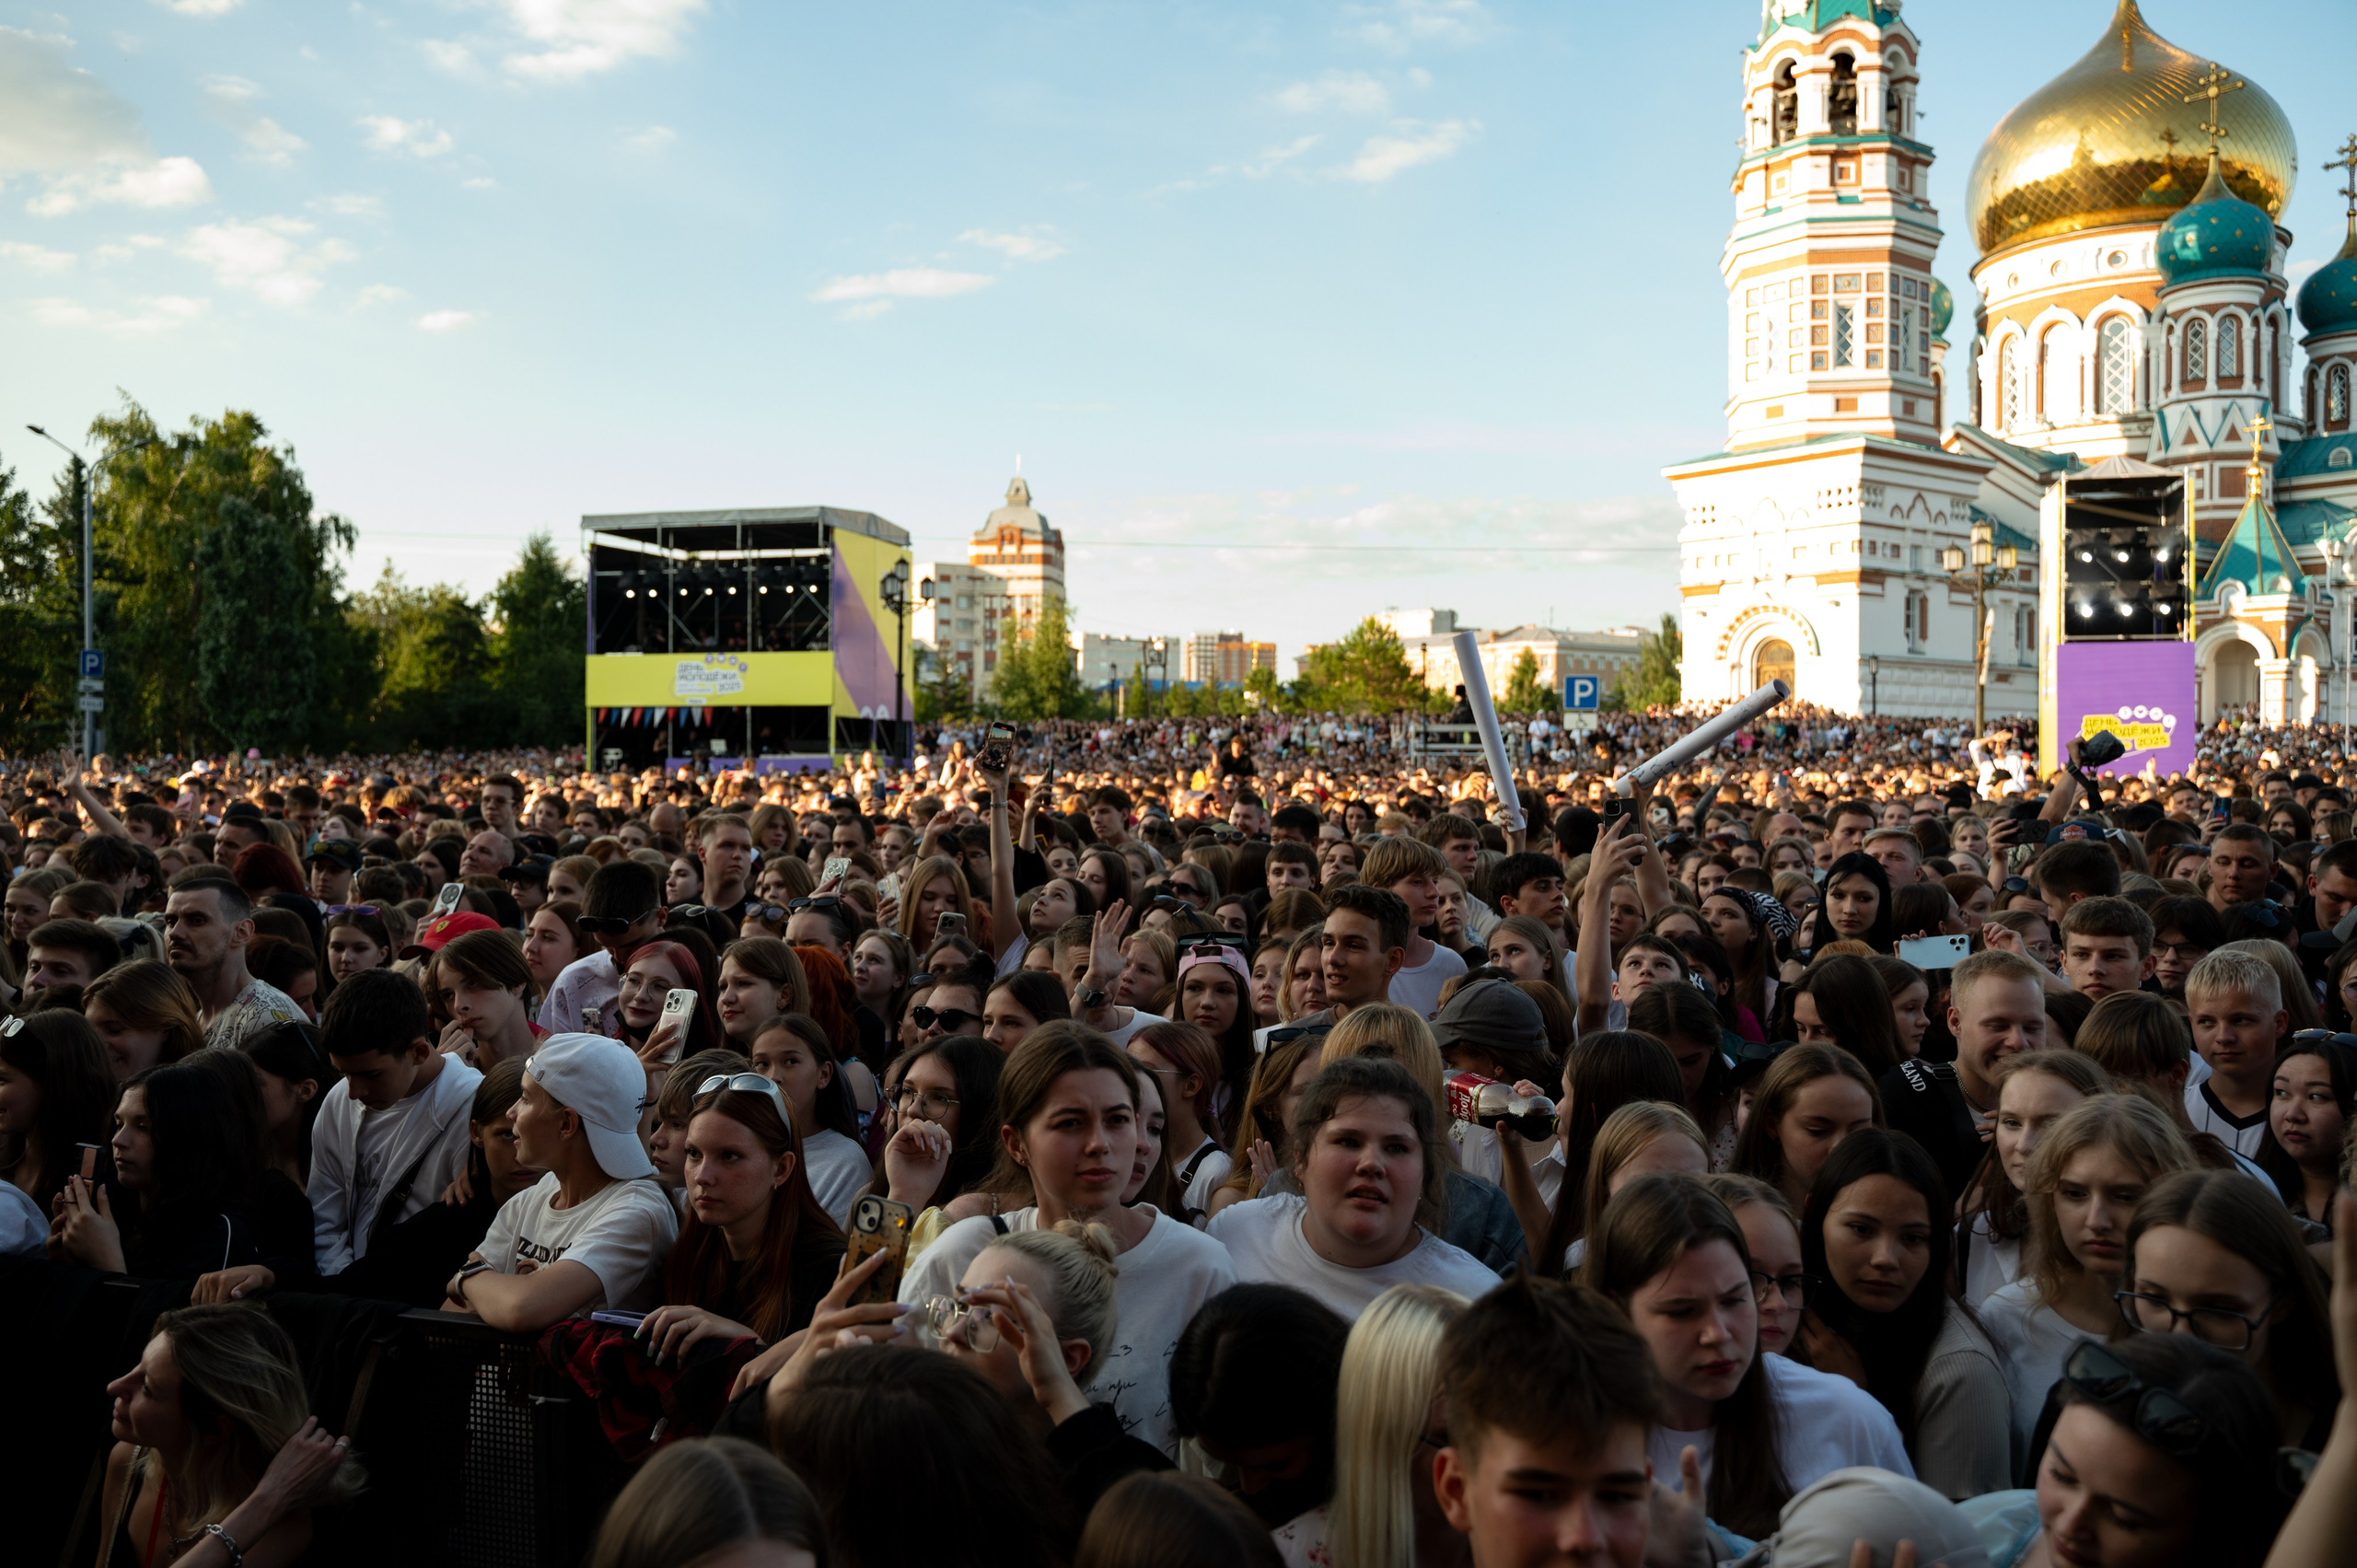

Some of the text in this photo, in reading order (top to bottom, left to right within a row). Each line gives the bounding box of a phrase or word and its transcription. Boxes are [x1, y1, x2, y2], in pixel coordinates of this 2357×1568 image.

[86, 653, 99, 674] P
[1573, 679, 1595, 706] P
[2084, 717, 2118, 727] ДЕНЬ
[2084, 726, 2161, 738] МОДЁЖИ
[2138, 736, 2167, 748] 2025
